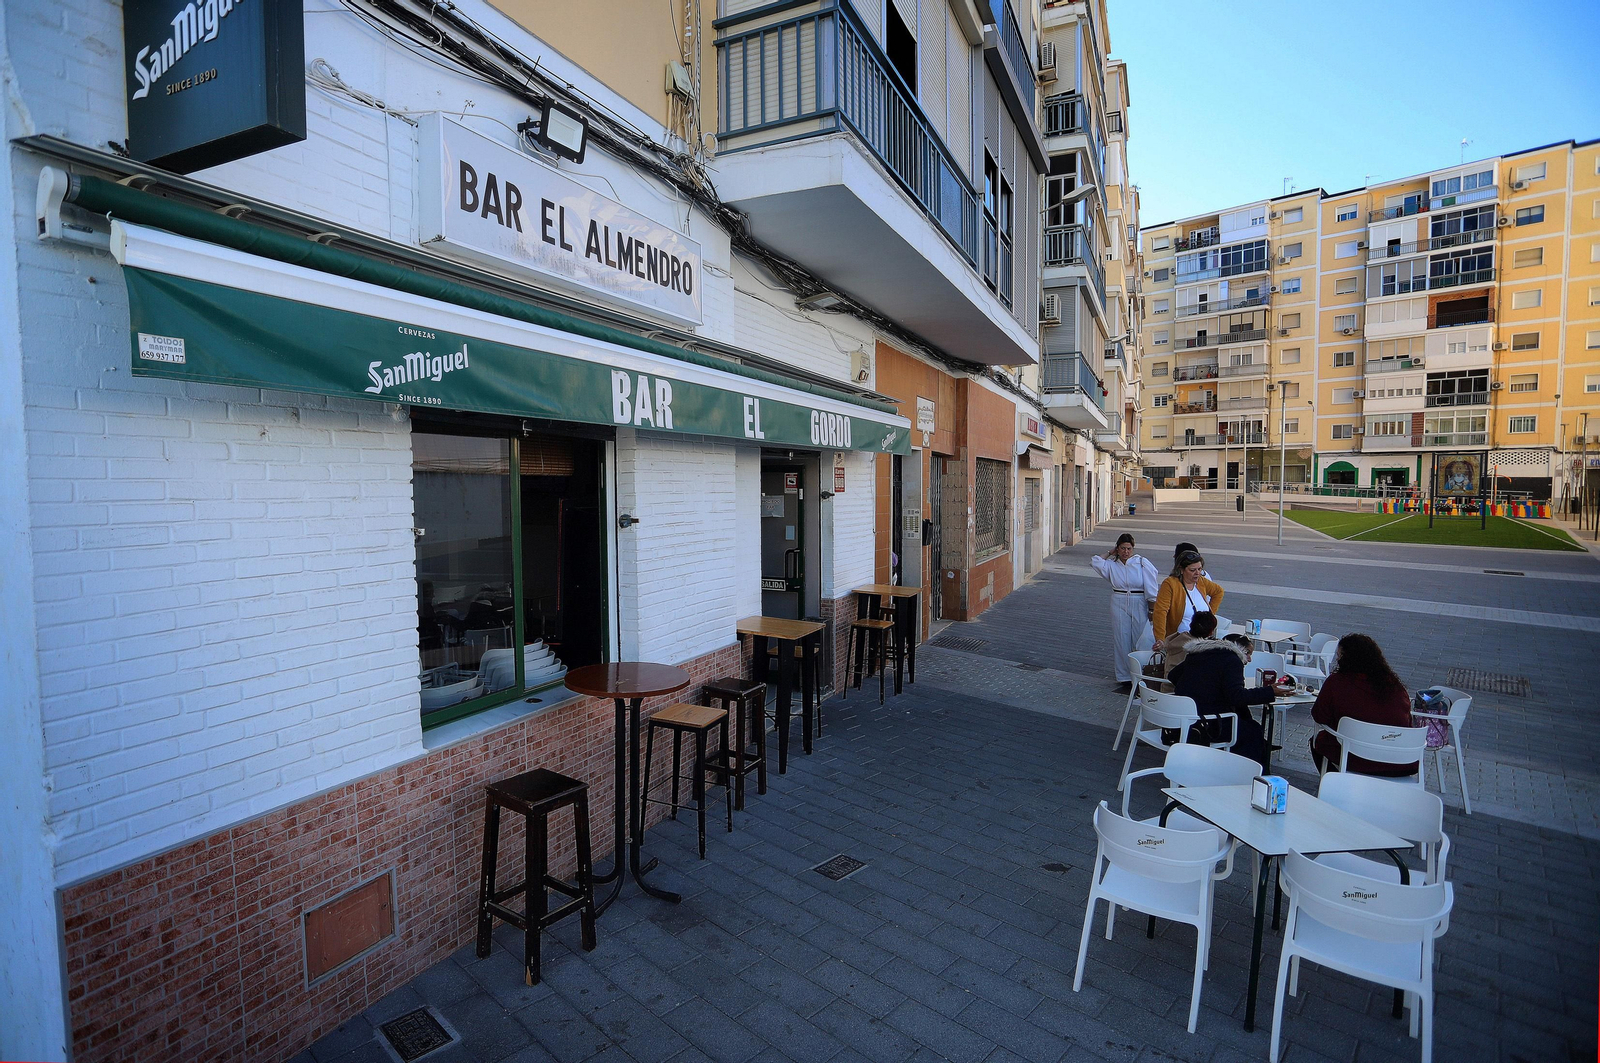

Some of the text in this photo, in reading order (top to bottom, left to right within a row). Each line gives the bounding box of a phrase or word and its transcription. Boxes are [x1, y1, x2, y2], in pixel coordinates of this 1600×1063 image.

[132, 0, 241, 100] SanMigu
[166, 68, 218, 95] SINCE 1890
[459, 159, 693, 296] BAR EL ALMENDRO
[152, 336, 183, 347] TOLDOS
[398, 326, 436, 340] CERVEZAS
[141, 350, 184, 363] 659 937 177
[398, 393, 442, 405] SINCE 1890
[611, 369, 851, 448] BAR EL GORDO
